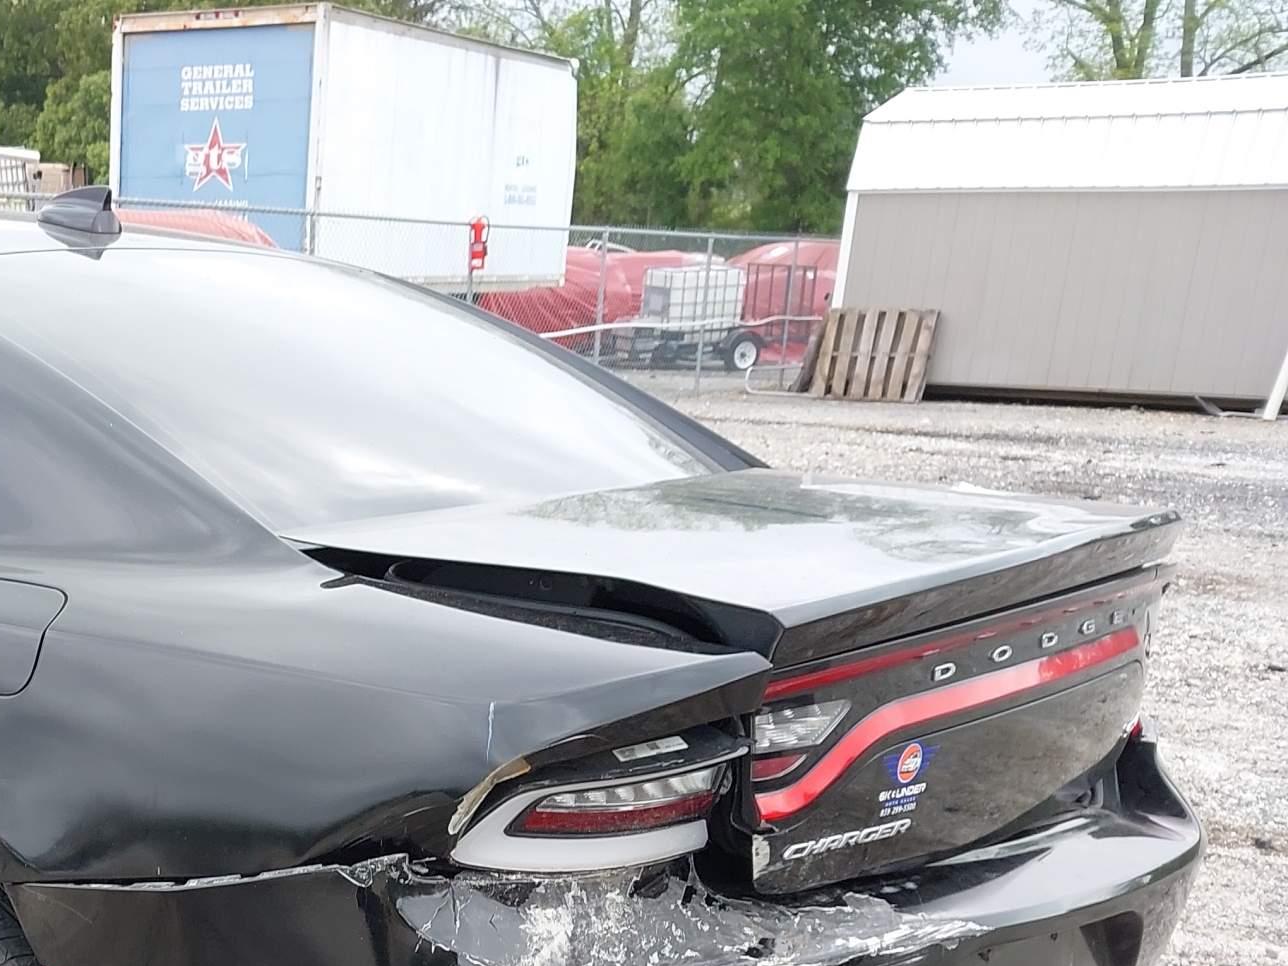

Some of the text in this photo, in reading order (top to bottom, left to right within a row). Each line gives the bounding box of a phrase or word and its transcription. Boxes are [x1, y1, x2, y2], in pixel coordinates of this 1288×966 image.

[181, 63, 254, 79] GENERAL
[181, 79, 253, 95] TRAILER
[180, 95, 253, 111] SERVICES
[933, 609, 1126, 682] DODGE
[782, 818, 912, 860] CHARGER
